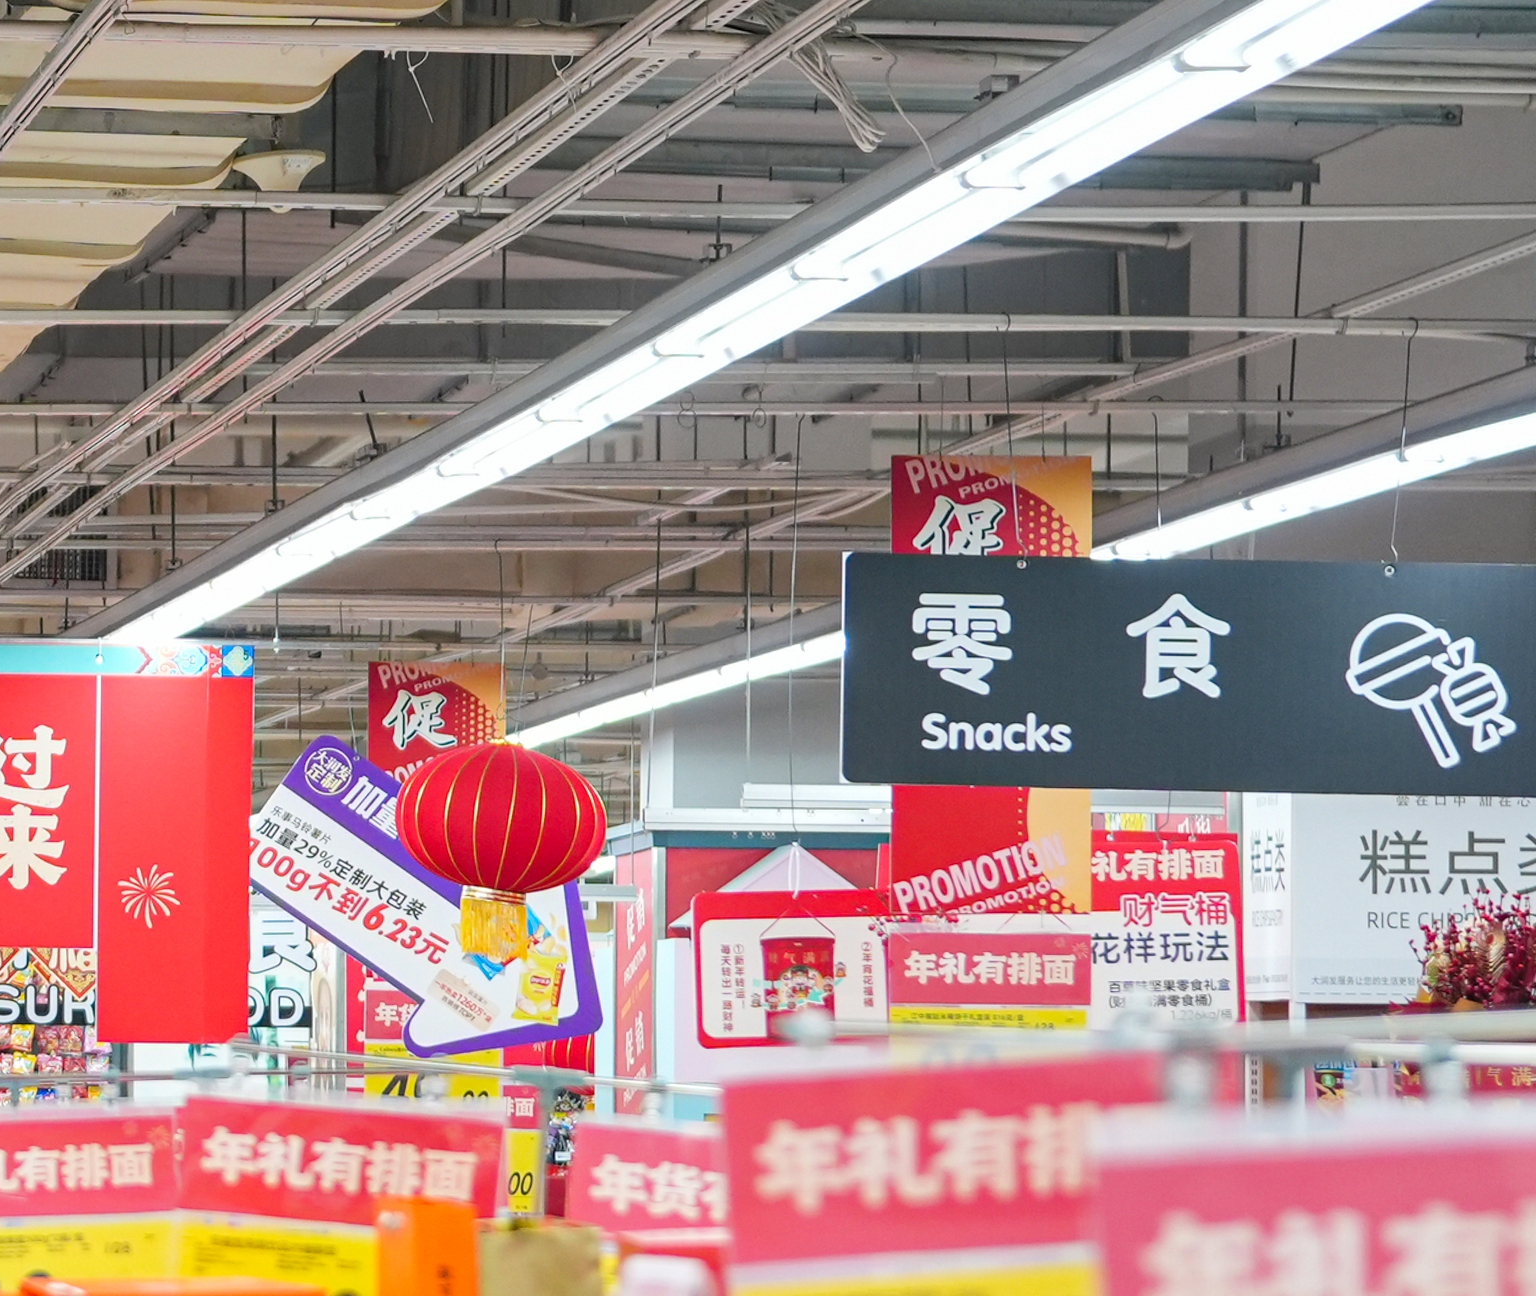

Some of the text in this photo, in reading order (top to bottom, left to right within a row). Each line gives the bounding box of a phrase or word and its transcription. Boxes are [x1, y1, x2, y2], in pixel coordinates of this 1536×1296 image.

[911, 592, 1231, 699] 零食
[382, 690, 459, 750] 促
[920, 712, 1072, 754] Snacks
[304, 763, 343, 794] 定制
[311, 748, 353, 782] 大润发
[270, 805, 333, 845] 乐事马铃薯片
[256, 816, 428, 921] 加量29%定制大包装
[892, 832, 1068, 915] PROMOTION
[1119, 892, 1230, 928] 财气桶
[1367, 911, 1411, 929] RICE
[904, 949, 1078, 986] 年礼有排面
[1091, 930, 1231, 965] 花样玩法
[200, 1124, 477, 1201] 年礼有排面
